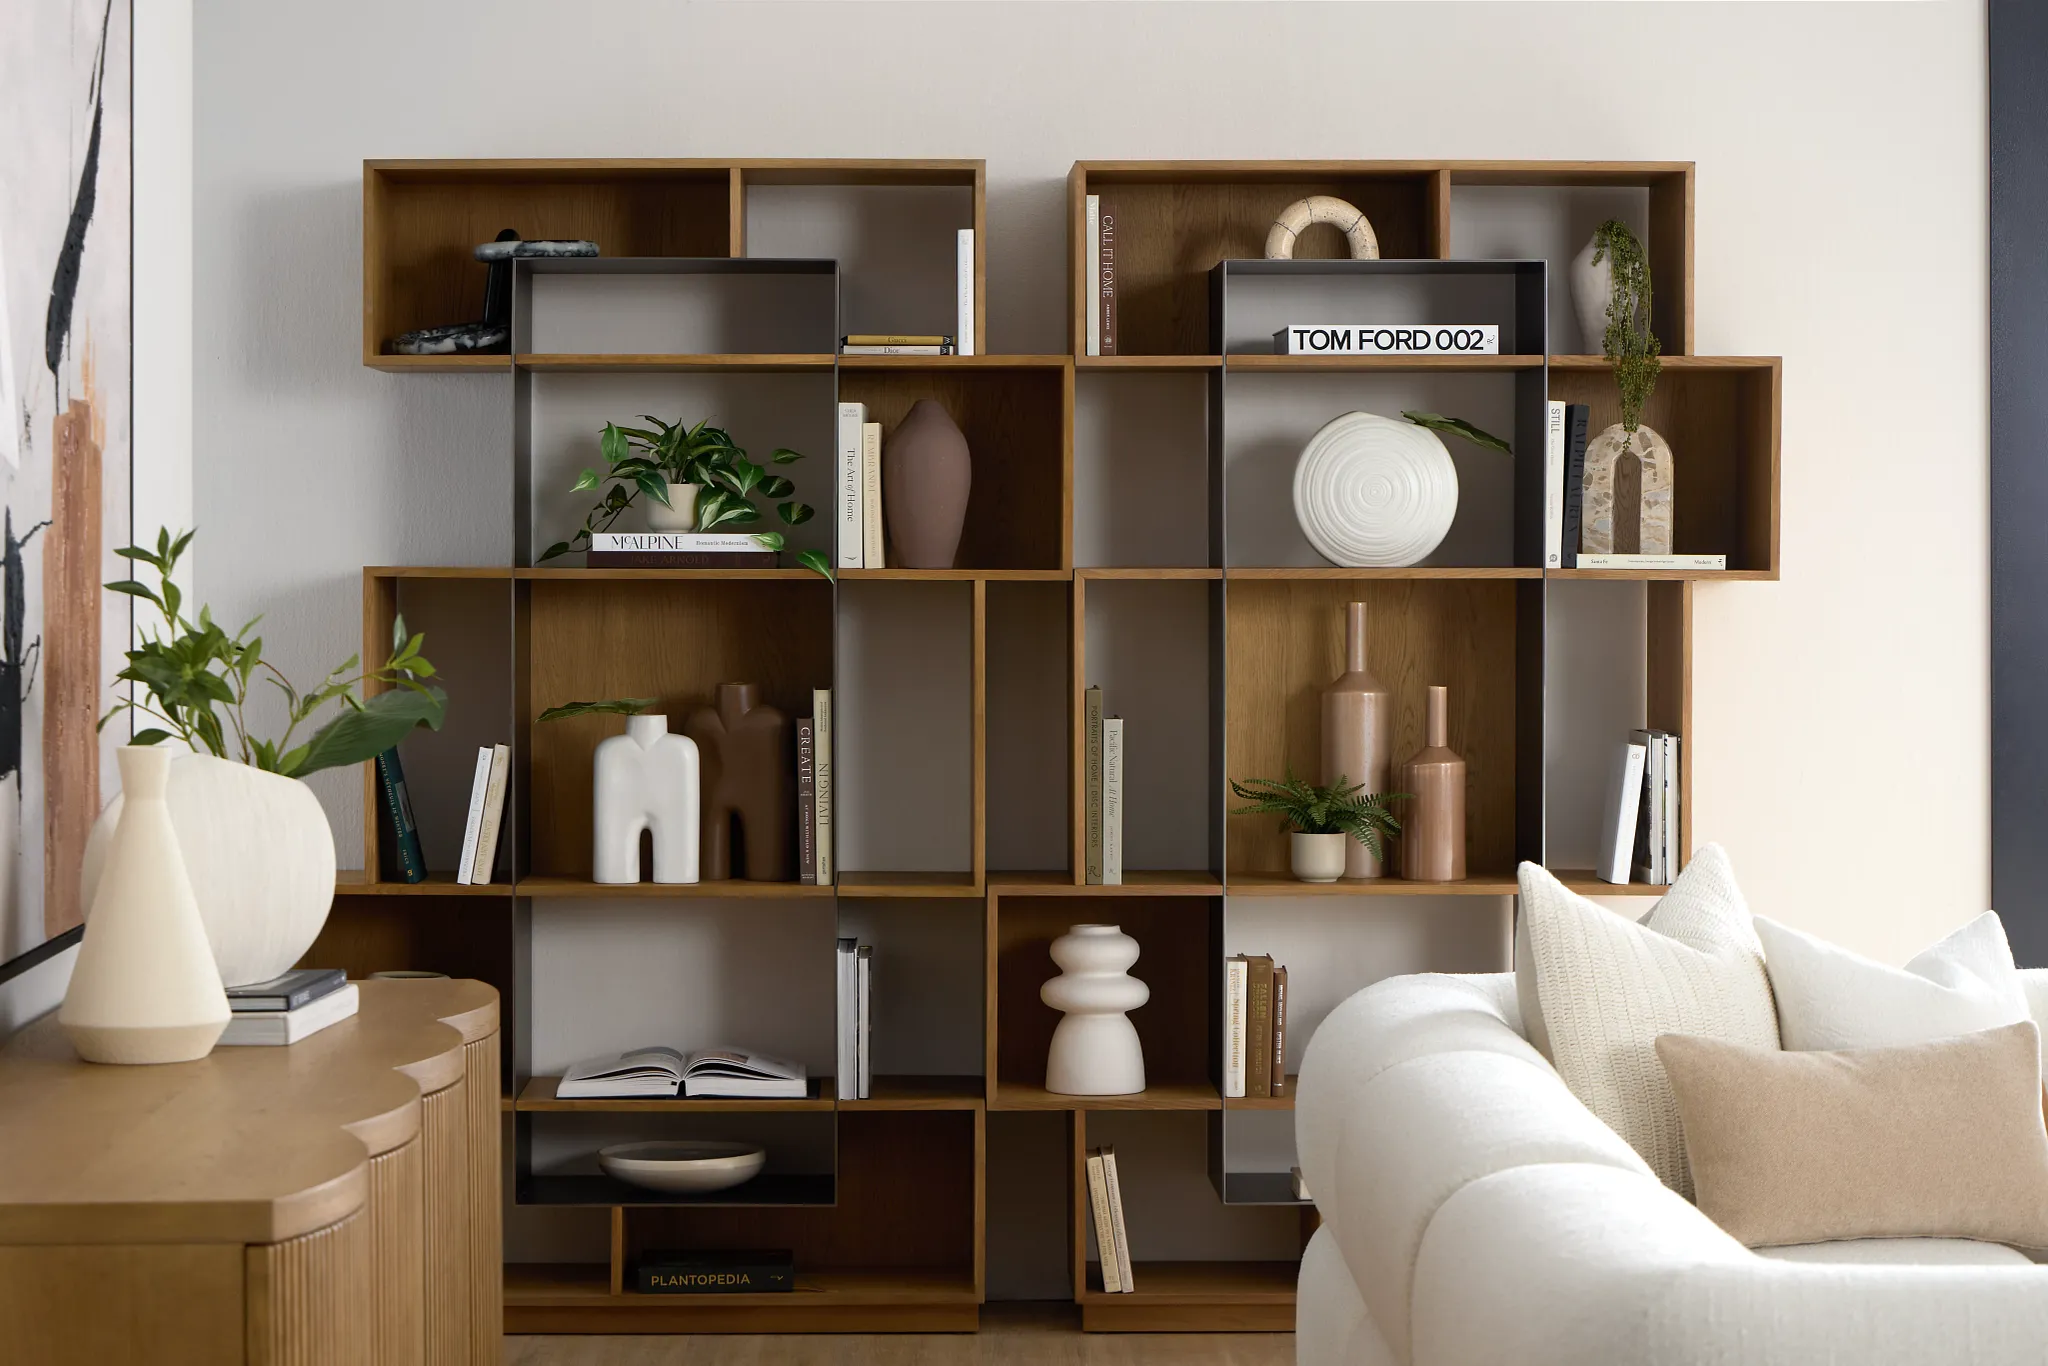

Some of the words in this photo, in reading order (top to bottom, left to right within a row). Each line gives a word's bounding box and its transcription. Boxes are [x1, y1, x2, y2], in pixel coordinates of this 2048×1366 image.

[1102, 215, 1113, 245] CALL
[1102, 248, 1113, 259] IT
[1102, 262, 1113, 298] HOME
[888, 336, 906, 344] Gucci
[1293, 330, 1351, 350] TOM
[1358, 330, 1431, 350] FORD
[1435, 330, 1484, 350] 002
[1550, 408, 1560, 434] STILL
[1573, 419, 1587, 468] RALPH
[847, 448, 855, 466] The
[867, 434, 876, 492] REMBRANDT
[847, 468, 855, 482] Art
[845, 484, 855, 492] of
[847, 494, 855, 522] Home
[1568, 473, 1582, 532] LAUREN
[631, 555, 657, 564] JAKE
[661, 555, 709, 564] ARNOLD
[1090, 705, 1098, 744] PORTRAITS
[1090, 746, 1098, 756] OF
[1108, 730, 1118, 754] Pacific
[800, 727, 812, 783] CREATE
[818, 763, 828, 776] IN
[1090, 760, 1098, 782] HOME
[1108, 755, 1118, 782] Natural
[1108, 785, 1117, 794] At
[818, 780, 828, 825] LIVING
[1108, 796, 1117, 818] Home
[1231, 998, 1241, 1024] Spring
[1232, 1026, 1240, 1068] Collection
[651, 1274, 750, 1286] PLANTOPEDIA
